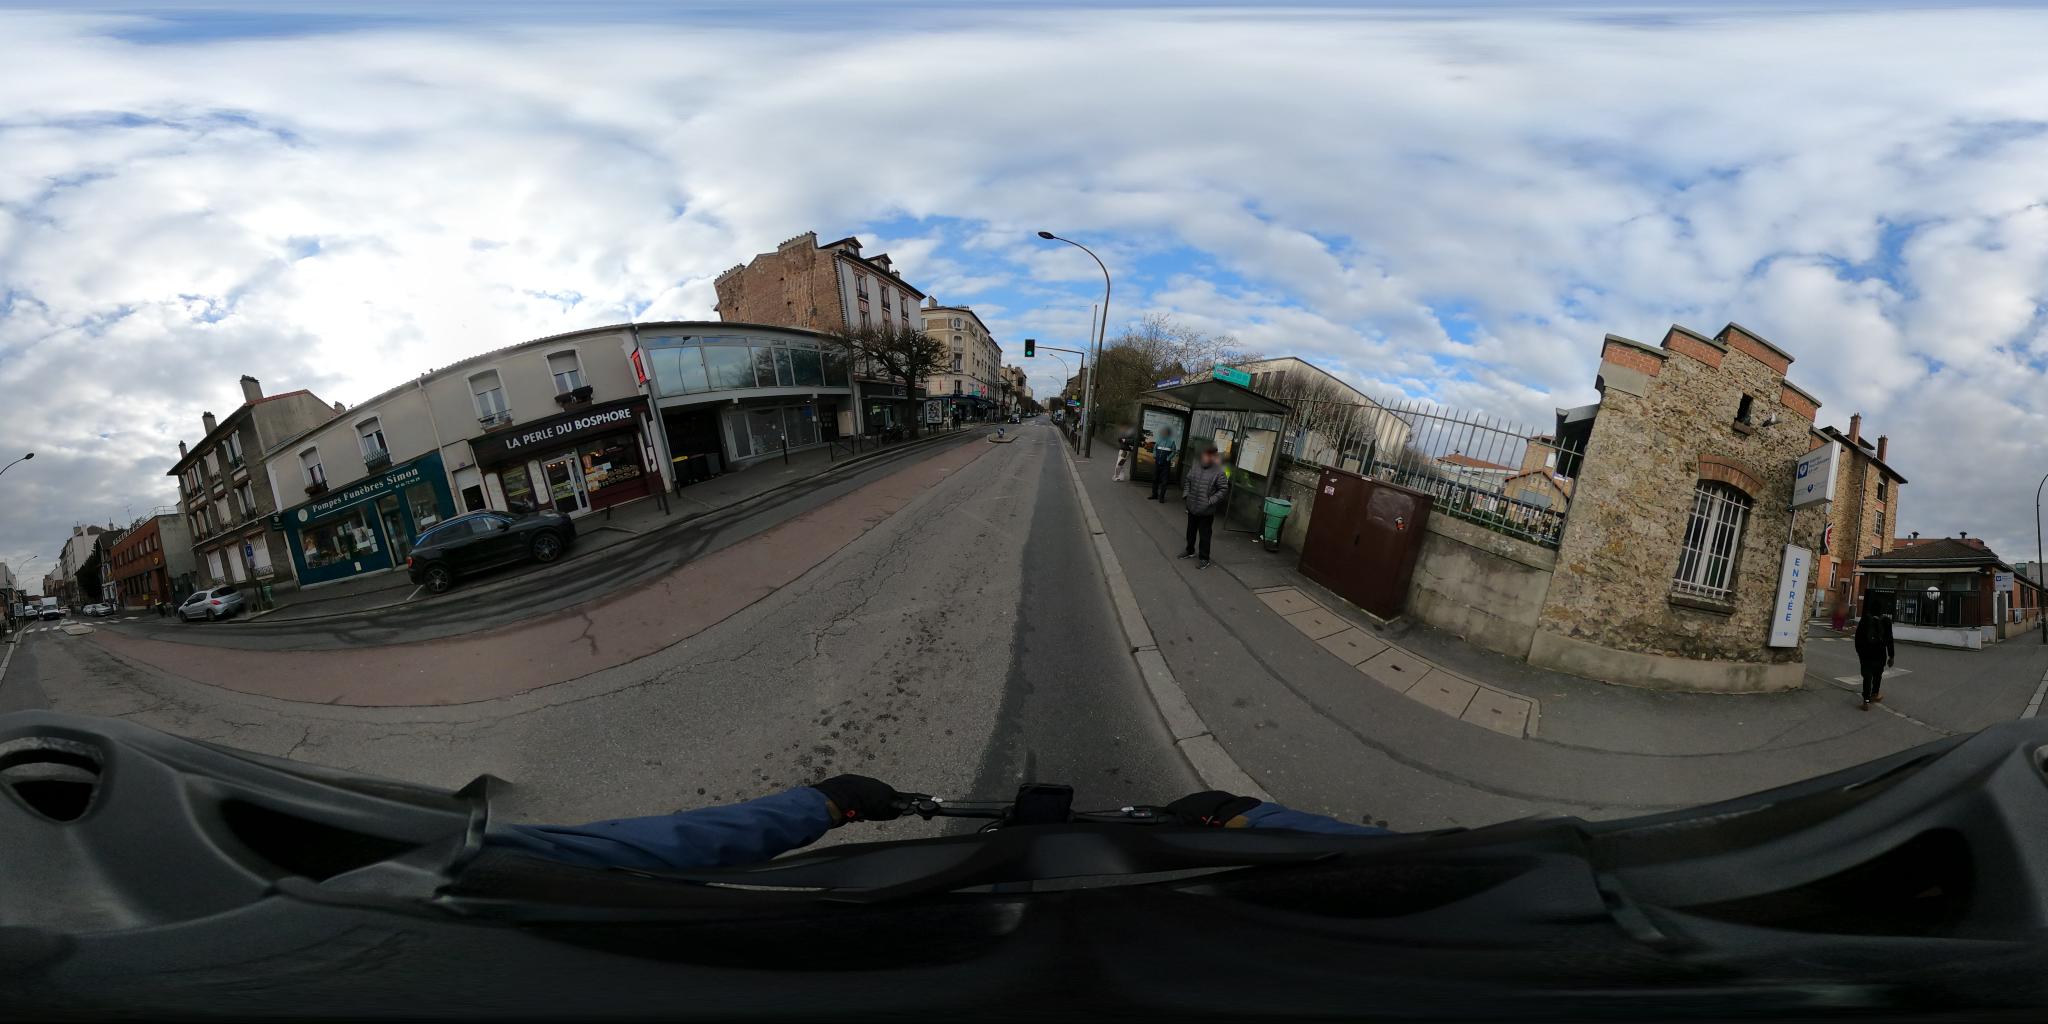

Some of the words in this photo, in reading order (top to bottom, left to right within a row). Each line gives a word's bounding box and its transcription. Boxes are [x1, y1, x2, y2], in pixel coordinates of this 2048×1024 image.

[505, 437, 522, 449] LA
[522, 427, 554, 445] PERLE
[555, 422, 573, 435] DU
[574, 408, 632, 430] BOSPHORE
[312, 497, 342, 512] Pompes
[343, 480, 384, 501] Funèbres
[386, 468, 419, 485] Simon
[1785, 557, 1801, 622] ENTRÉE
